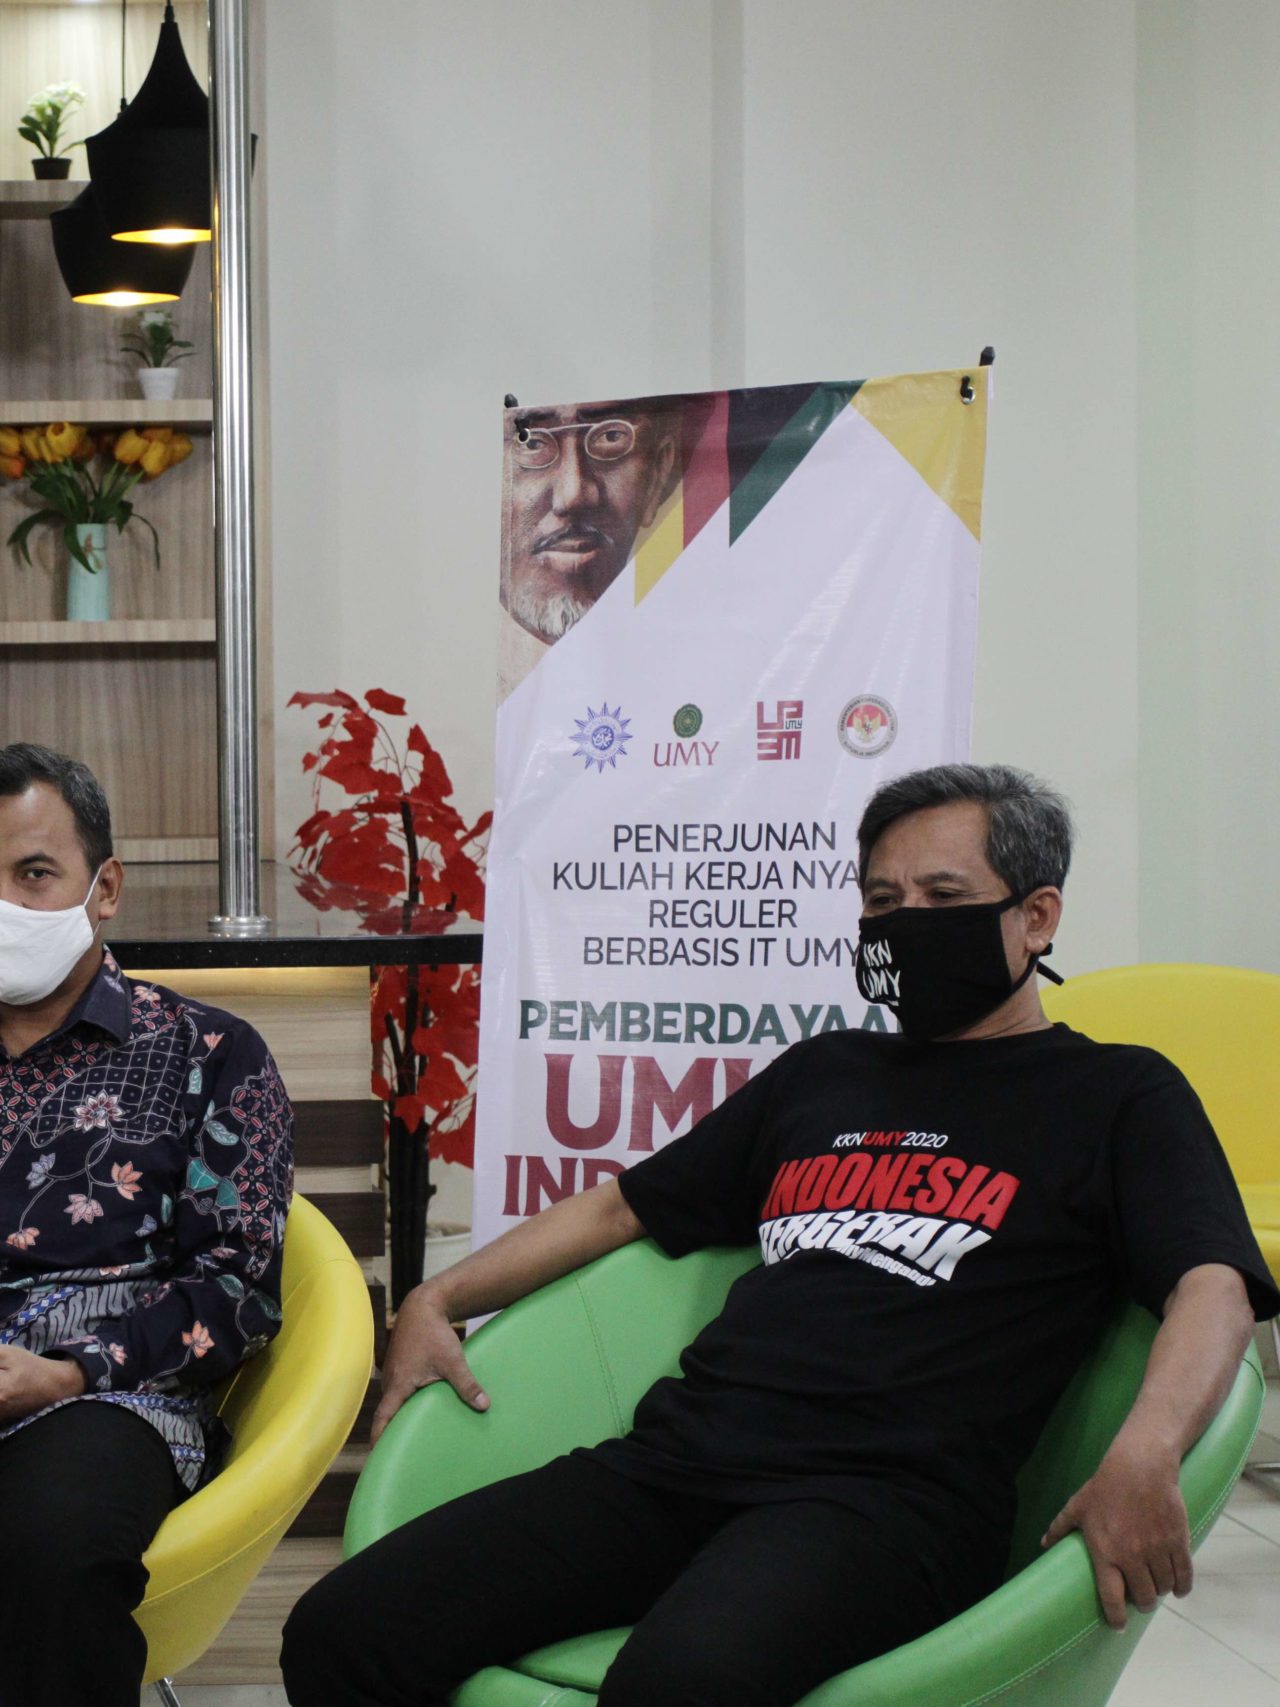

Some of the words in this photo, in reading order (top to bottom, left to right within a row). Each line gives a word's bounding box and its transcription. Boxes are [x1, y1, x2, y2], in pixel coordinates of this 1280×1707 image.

[653, 741, 720, 767] UMY
[613, 821, 837, 853] PENERJUNAN
[553, 861, 673, 890] KULIAH
[685, 860, 784, 890] KERJA
[793, 860, 860, 890] NYA
[649, 899, 798, 929] REGULER
[583, 937, 739, 967] BERBASIS
[749, 938, 777, 967] IT
[786, 938, 859, 968] UMY
[862, 968, 900, 998] UMY
[519, 1000, 903, 1045] PEMBERDAYAA
[832, 1131, 949, 1149] KKNUMY2020
[761, 1152, 1020, 1231] INDONESIA
[758, 1210, 993, 1281] BERGERAK
